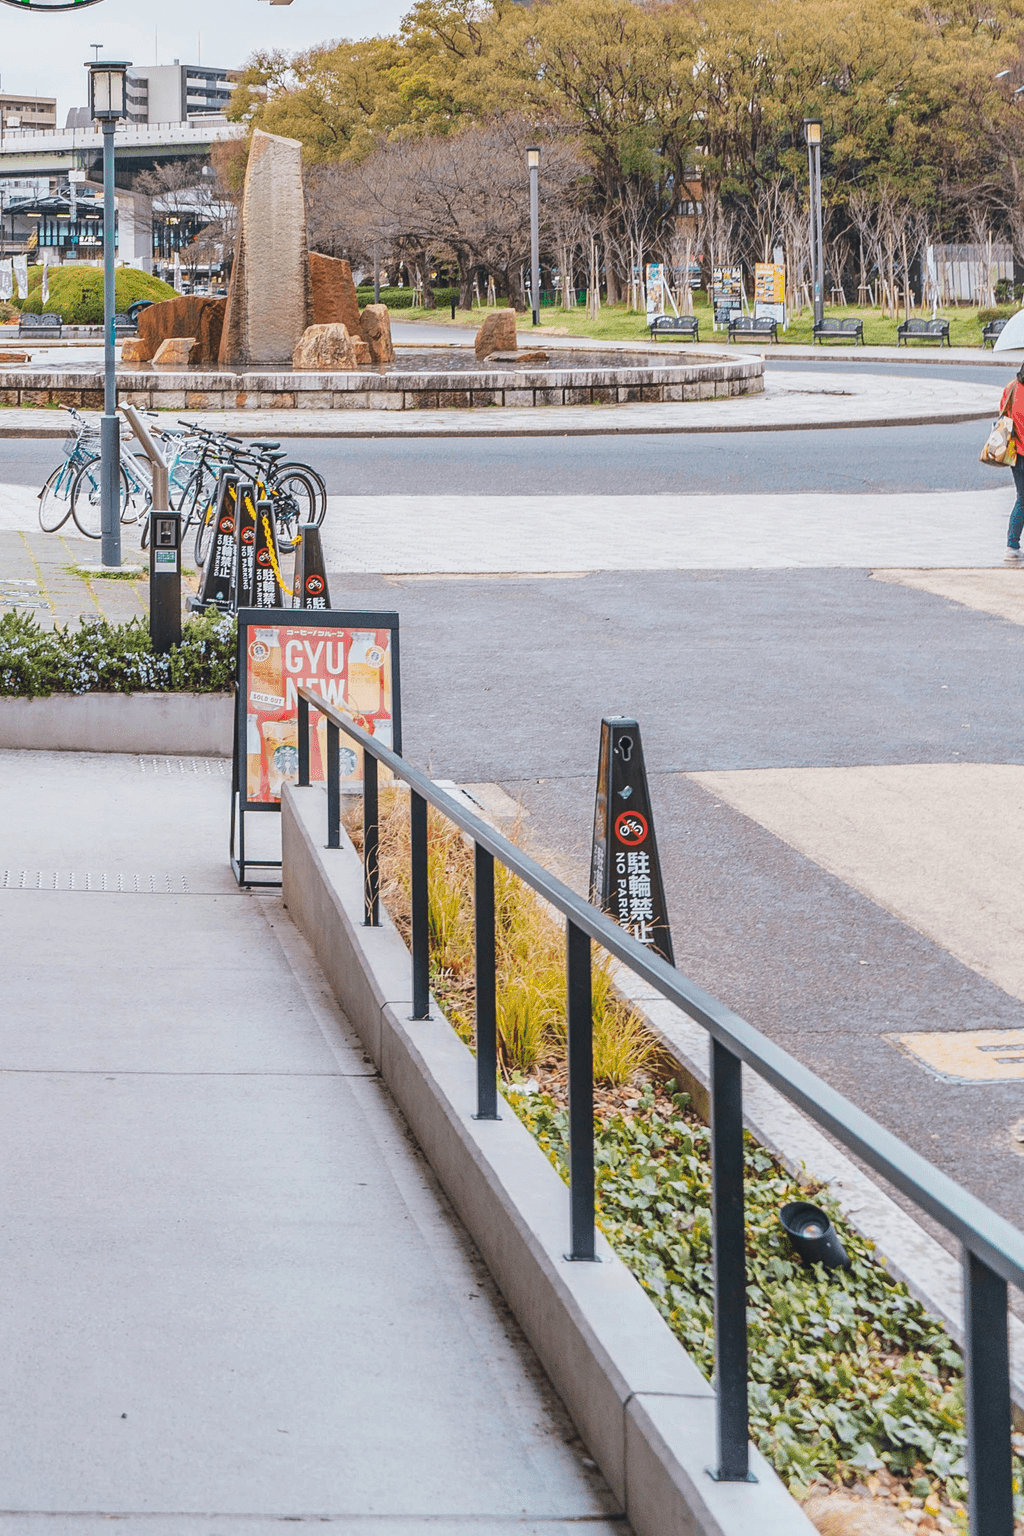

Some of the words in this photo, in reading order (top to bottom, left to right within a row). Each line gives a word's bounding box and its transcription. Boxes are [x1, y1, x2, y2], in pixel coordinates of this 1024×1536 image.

[217, 534, 223, 545] NO
[219, 534, 234, 578] 駐輪禁止
[241, 545, 247, 557] NO
[256, 568, 263, 581] NO
[262, 568, 275, 608] 駐輪禁
[285, 639, 344, 675] GYU
[253, 693, 269, 702] SOLD
[270, 697, 282, 705] OUT
[615, 852, 626, 874] NO
[627, 851, 655, 943] 駐輪禁止
